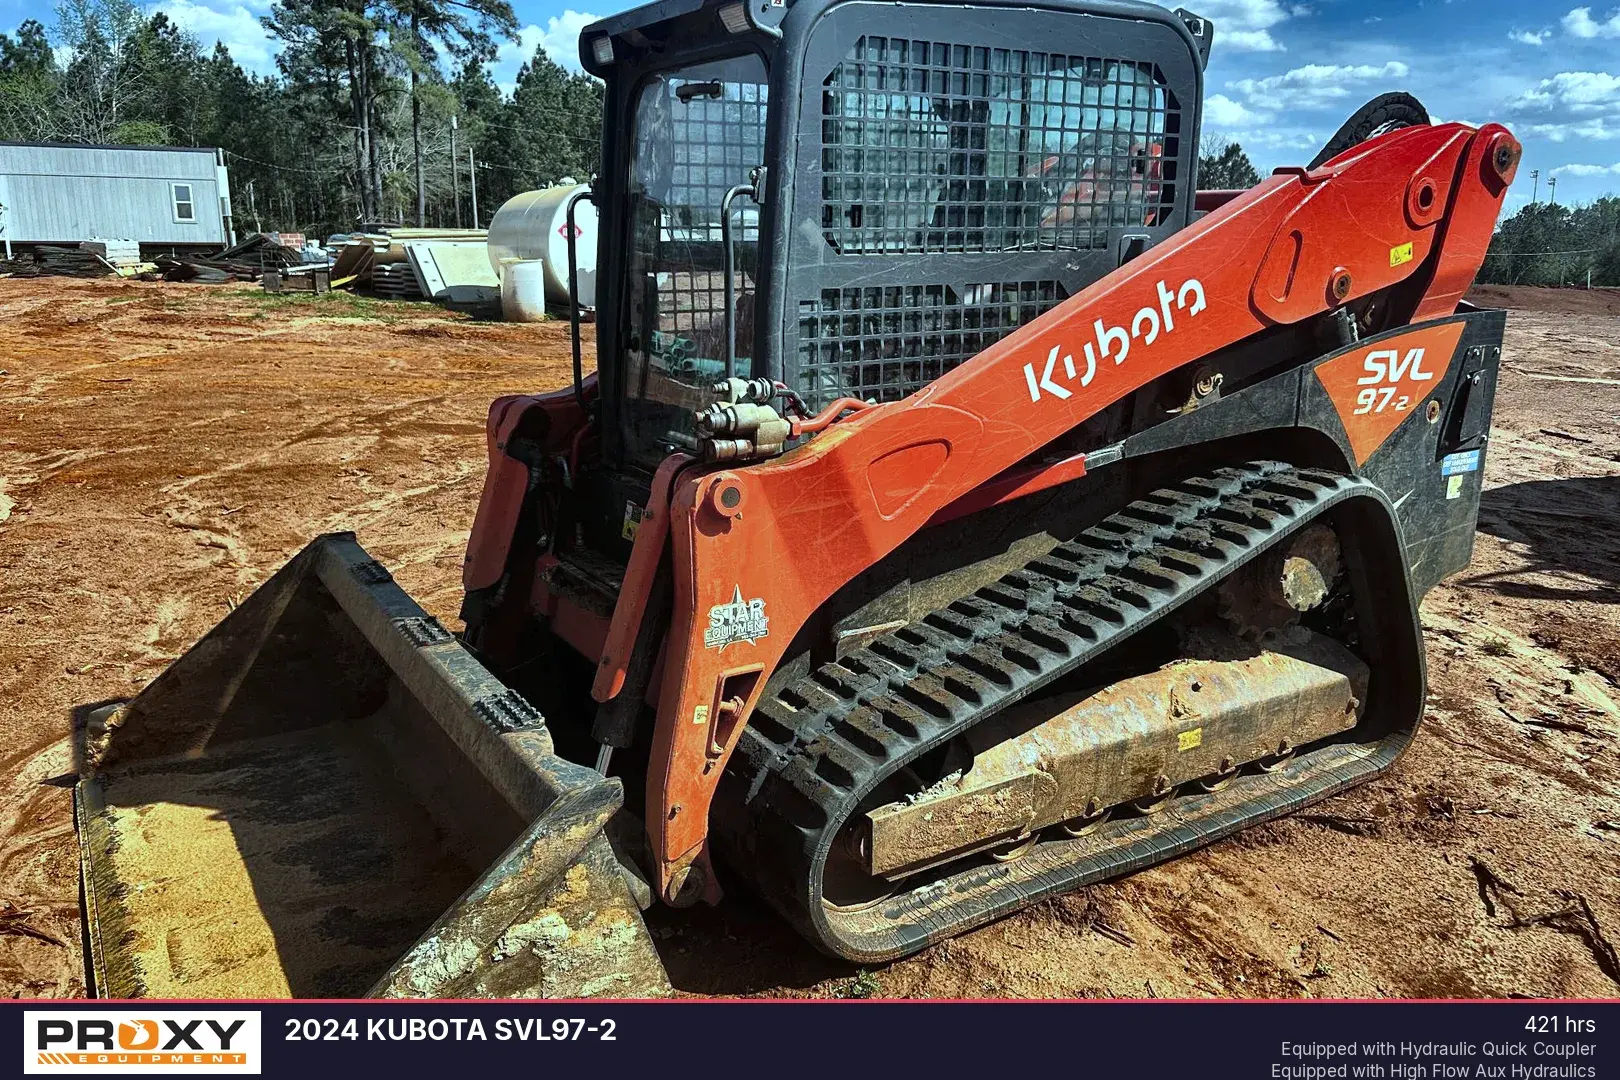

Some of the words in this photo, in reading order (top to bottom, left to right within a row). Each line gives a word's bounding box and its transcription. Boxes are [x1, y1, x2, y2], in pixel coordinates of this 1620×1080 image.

[1023, 279, 1207, 403] Kubota
[1357, 348, 1434, 386] SVL
[1353, 386, 1409, 415] 97-2
[709, 598, 765, 628] STAR
[705, 619, 768, 640] EQUIPMENT
